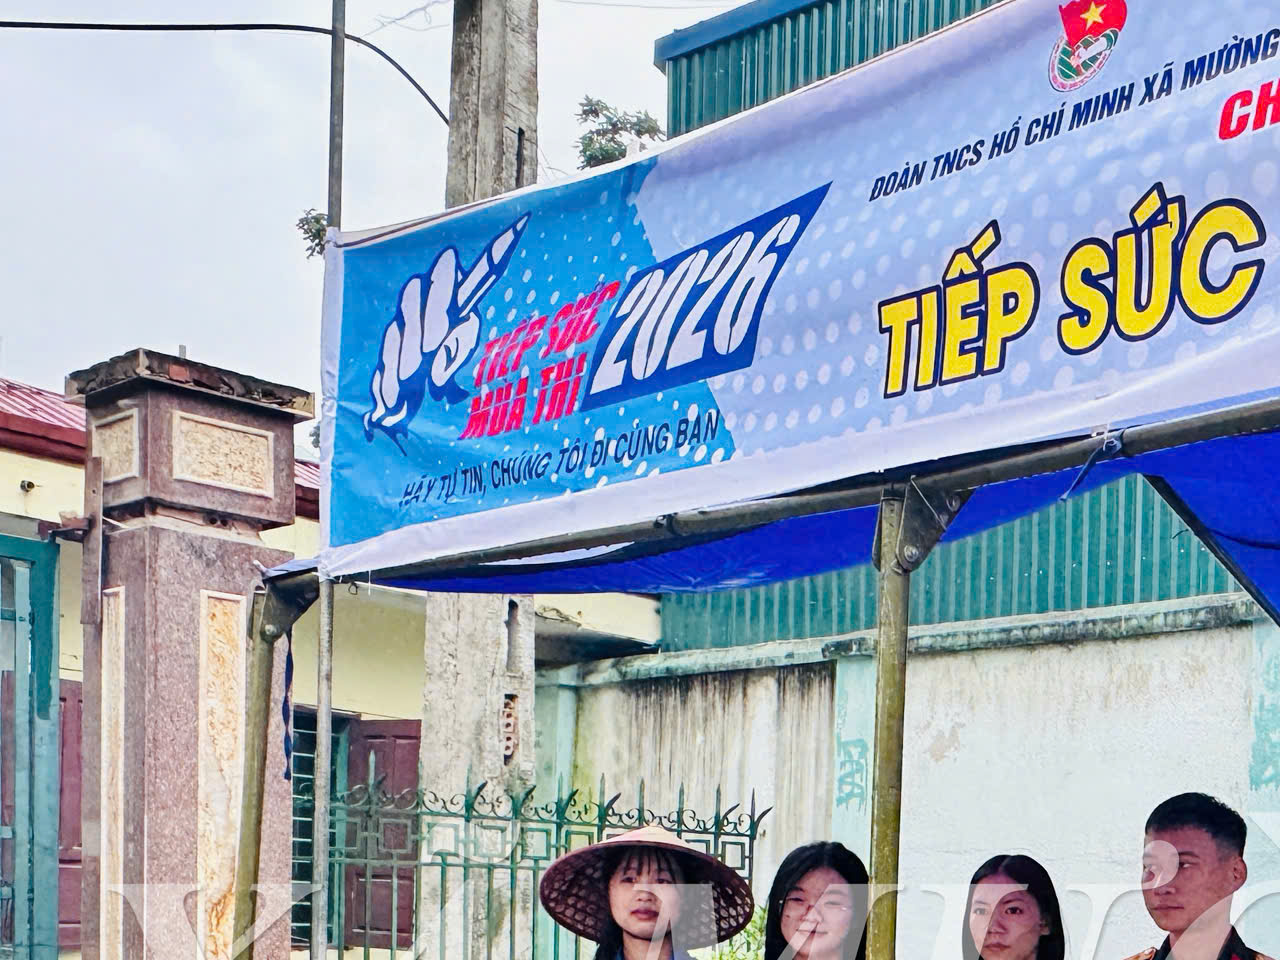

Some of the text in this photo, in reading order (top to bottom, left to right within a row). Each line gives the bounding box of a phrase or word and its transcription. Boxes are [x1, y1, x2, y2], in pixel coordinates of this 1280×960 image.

[869, 161, 926, 202] ĐOÀN
[930, 139, 985, 180] TNCS
[1025, 112, 1068, 147] CHÍ
[1068, 82, 1135, 132] MINH
[1139, 62, 1174, 107] XÃ
[1180, 27, 1280, 91] MƯỜNG
[474, 315, 549, 388] TIẾP
[588, 213, 801, 396] 2026
[879, 220, 1040, 398] TIẾP
[1057, 182, 1266, 355] SỨC
[532, 352, 587, 425] THI
[461, 463, 487, 497] TIN,
[491, 450, 553, 489] CHÚNG
[555, 438, 588, 475] TÔI
[590, 436, 611, 469] ĐI
